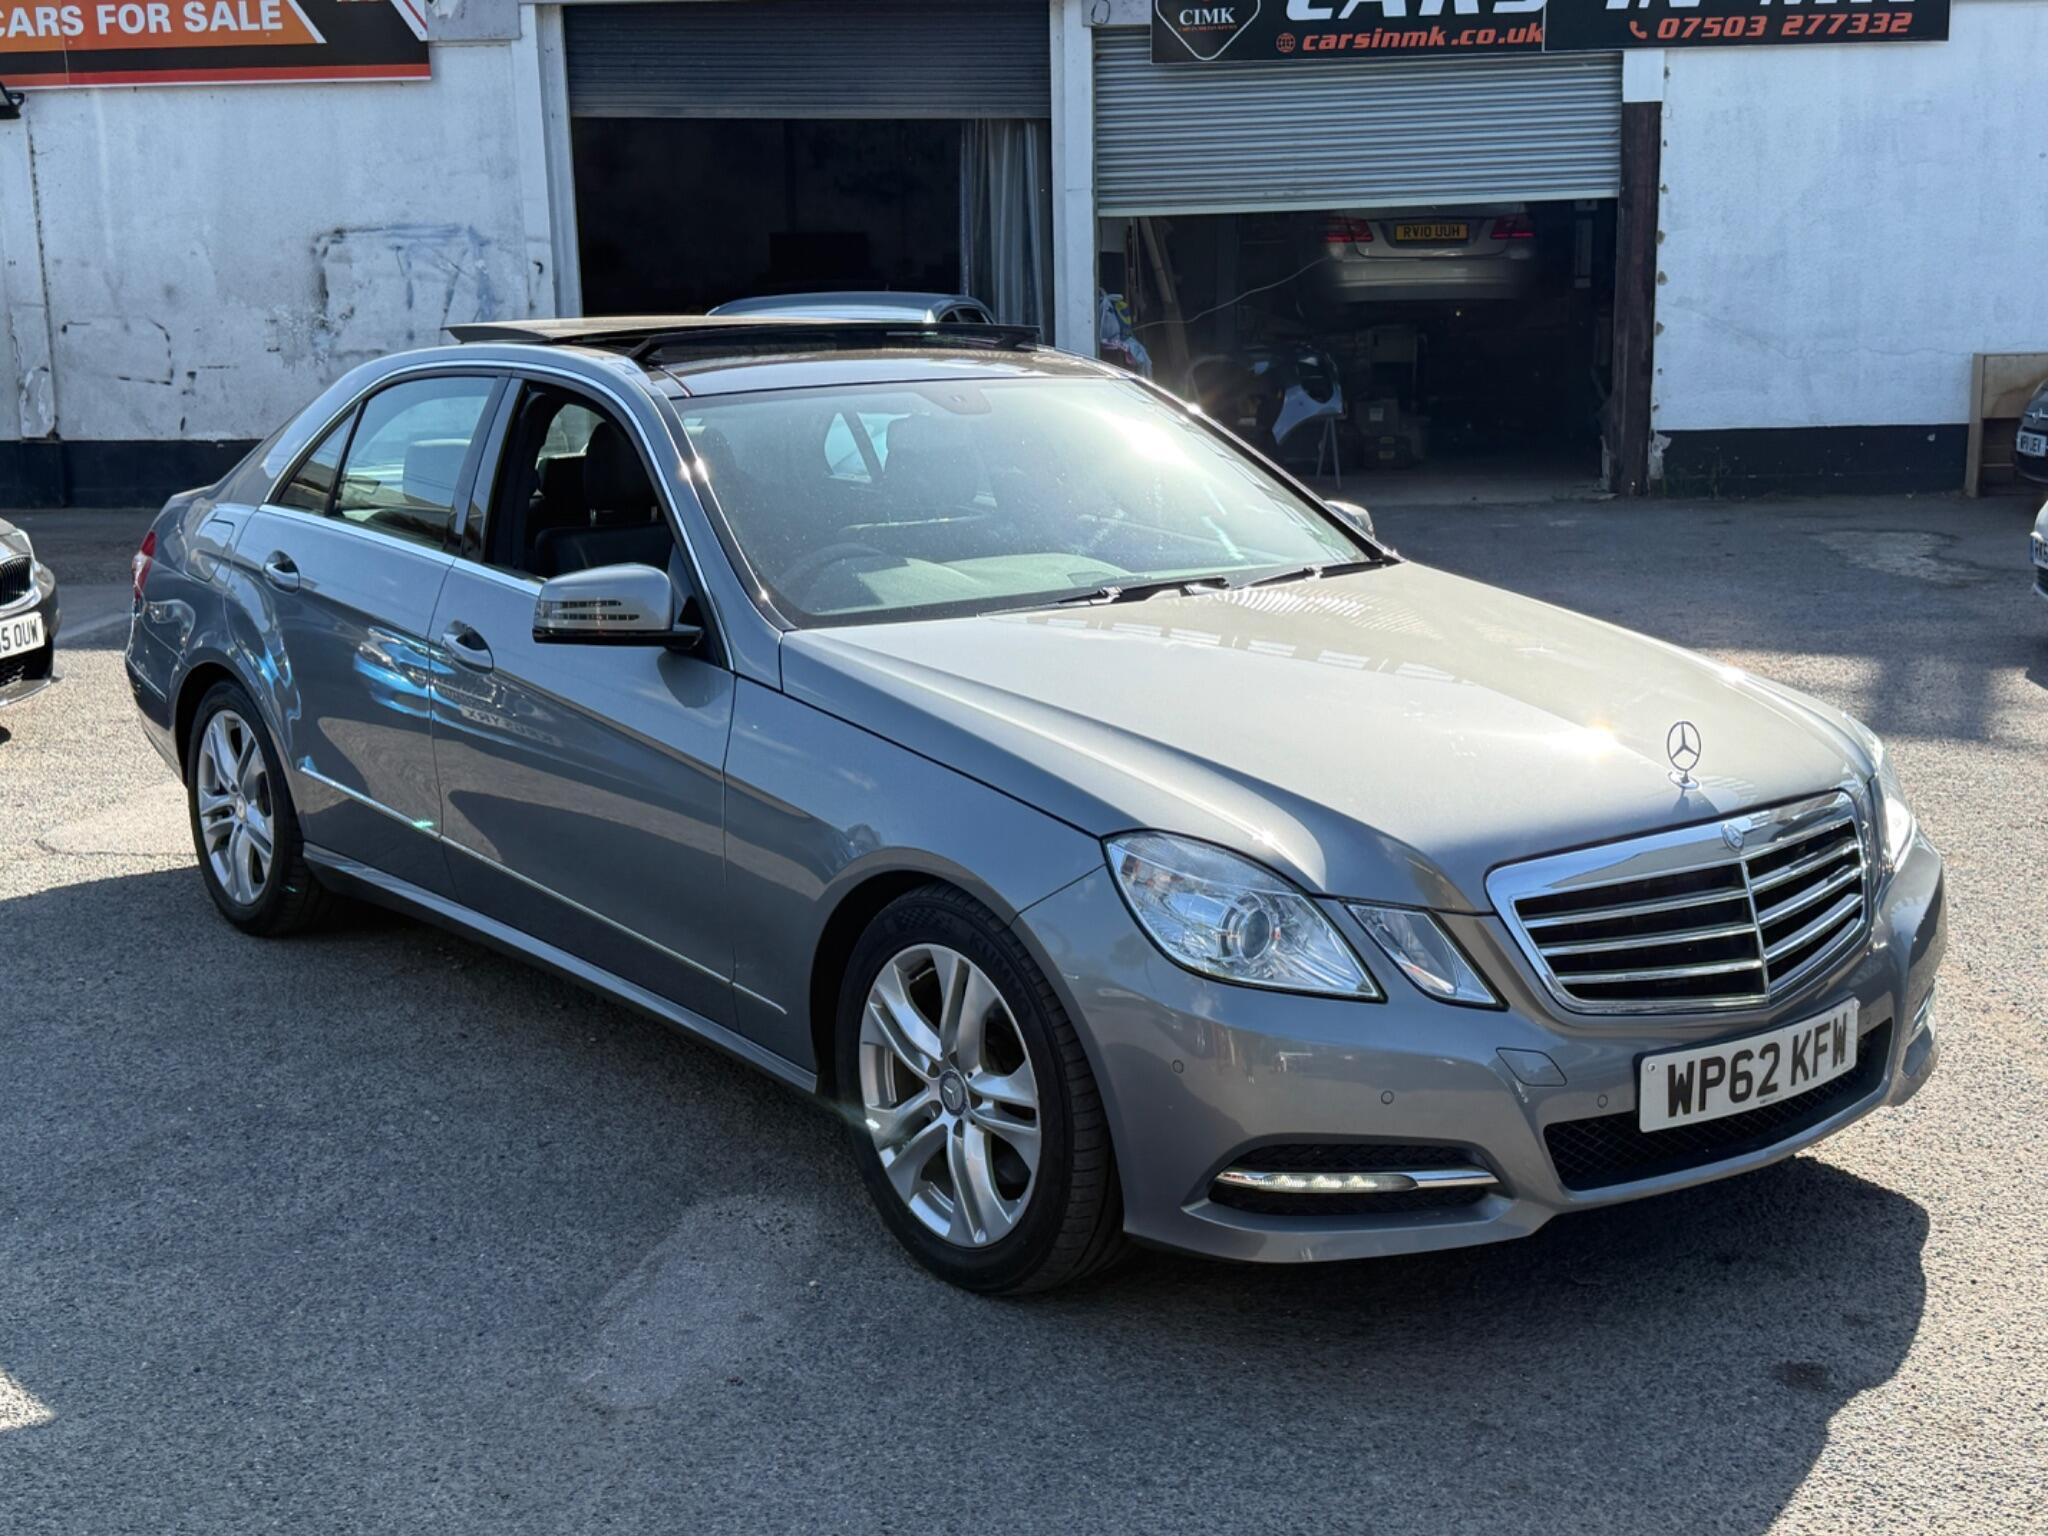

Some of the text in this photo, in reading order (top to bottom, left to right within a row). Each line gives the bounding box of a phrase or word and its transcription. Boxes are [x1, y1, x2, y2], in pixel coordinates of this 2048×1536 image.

[0, 0, 283, 38] ARS FOR SALE
[1179, 7, 1235, 25] CIMK
[1657, 12, 1913, 38] 07503 277332
[1302, 22, 1543, 50] carsinmk.co.uk
[1403, 224, 1460, 238] RV10 UUH
[0, 618, 38, 652] 5 OUW
[1667, 1013, 1848, 1118] WP62 KFW
